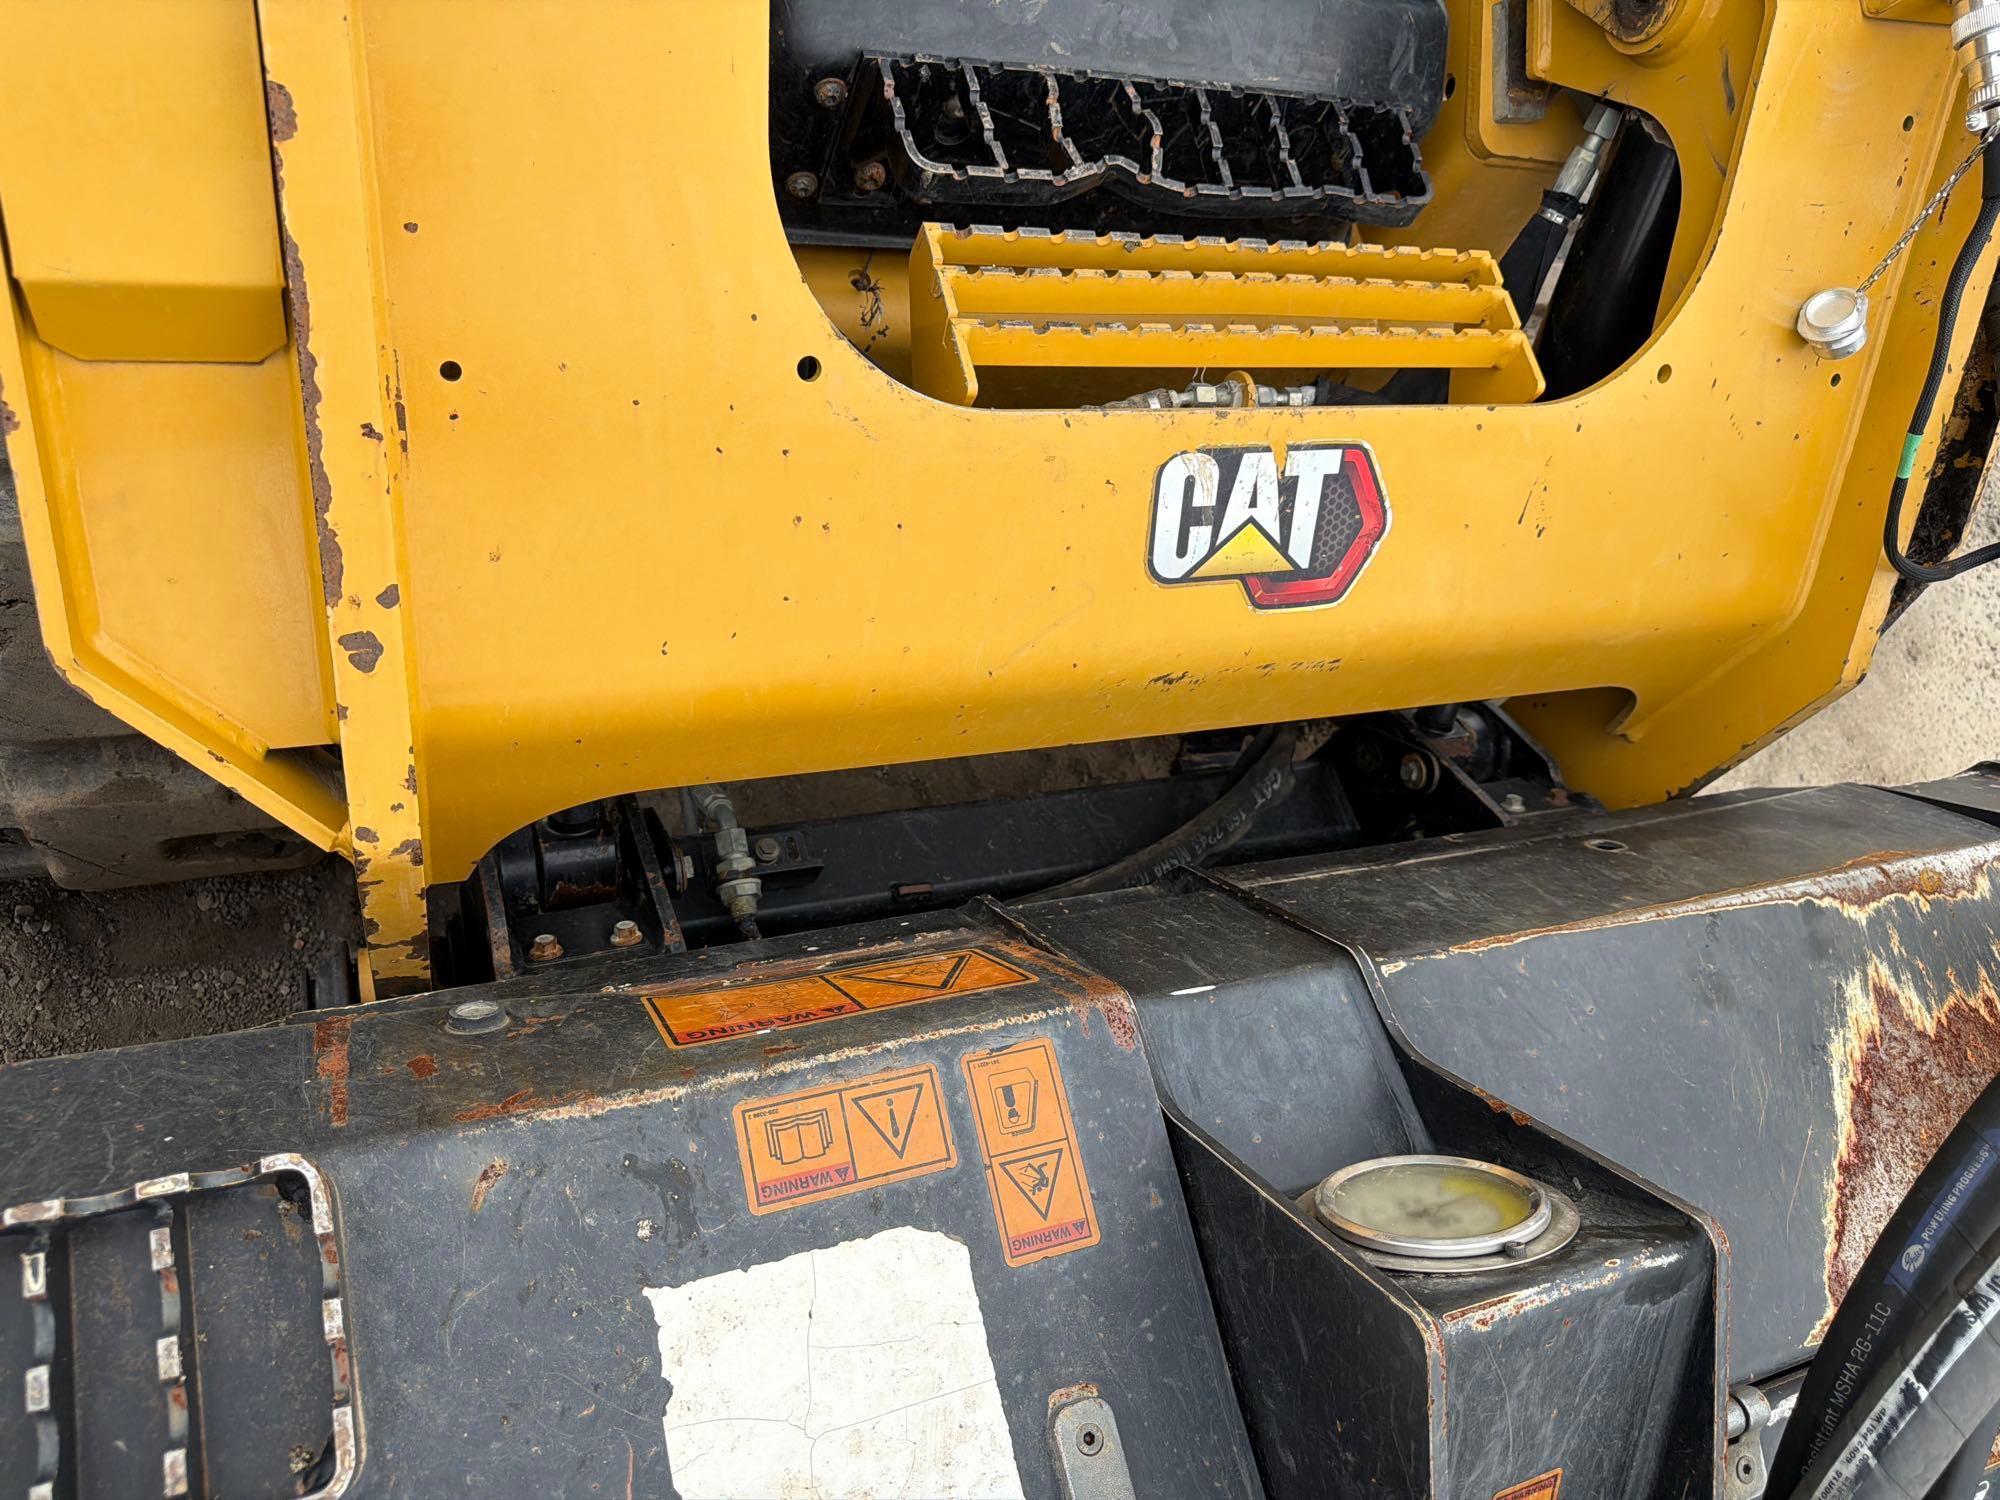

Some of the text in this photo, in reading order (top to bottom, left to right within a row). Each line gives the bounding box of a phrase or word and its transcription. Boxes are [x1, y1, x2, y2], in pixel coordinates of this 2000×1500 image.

[1153, 449, 1343, 579] CAT
[686, 1010, 820, 1040] WARNING
[760, 1170, 834, 1198] WARNING
[1920, 1194, 1957, 1241] POWERING
[1011, 1225, 1072, 1251] WARNING
[1829, 1362, 1861, 1409] MSHA
[1850, 1301, 1892, 1363] 2G-11C
[1860, 1423, 1877, 1442] PSI
[1873, 1407, 1887, 1425] WP
[1511, 1479, 1553, 1500] WARNING
